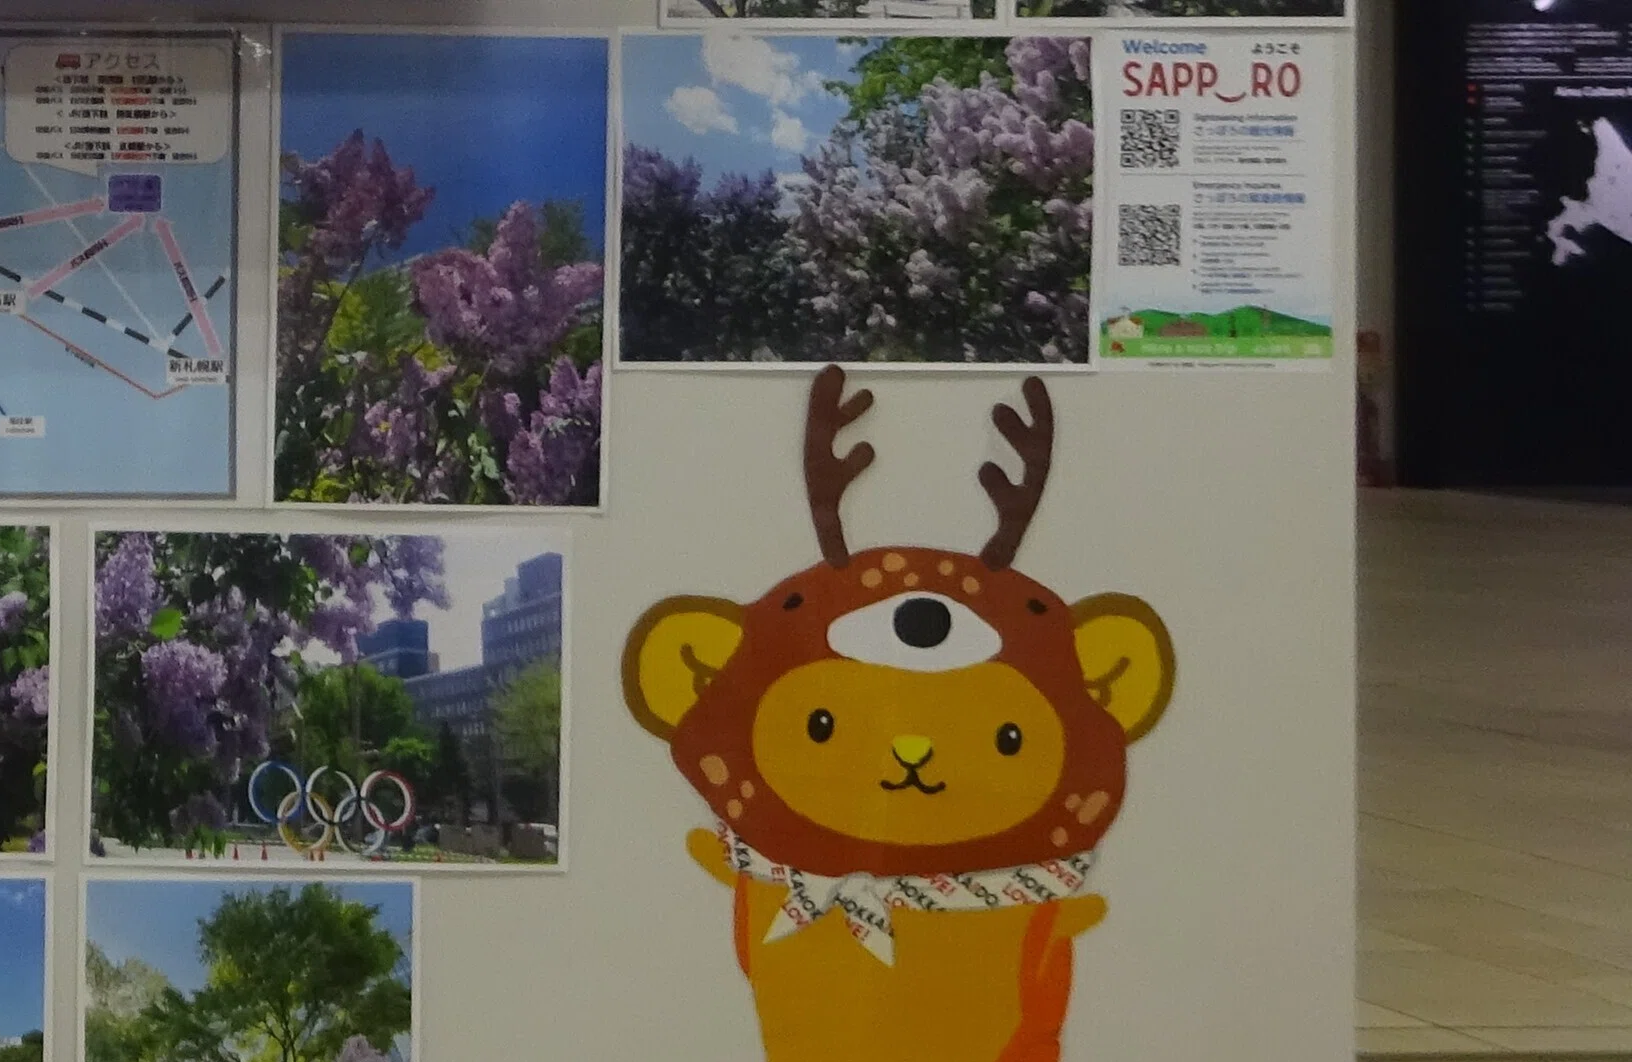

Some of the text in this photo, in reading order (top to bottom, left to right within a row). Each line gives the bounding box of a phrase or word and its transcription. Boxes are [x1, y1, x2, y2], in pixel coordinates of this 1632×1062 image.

[1123, 39, 1207, 54] Welcome
[86, 53, 160, 70] アクセス
[169, 360, 224, 373] 新札幌駅
